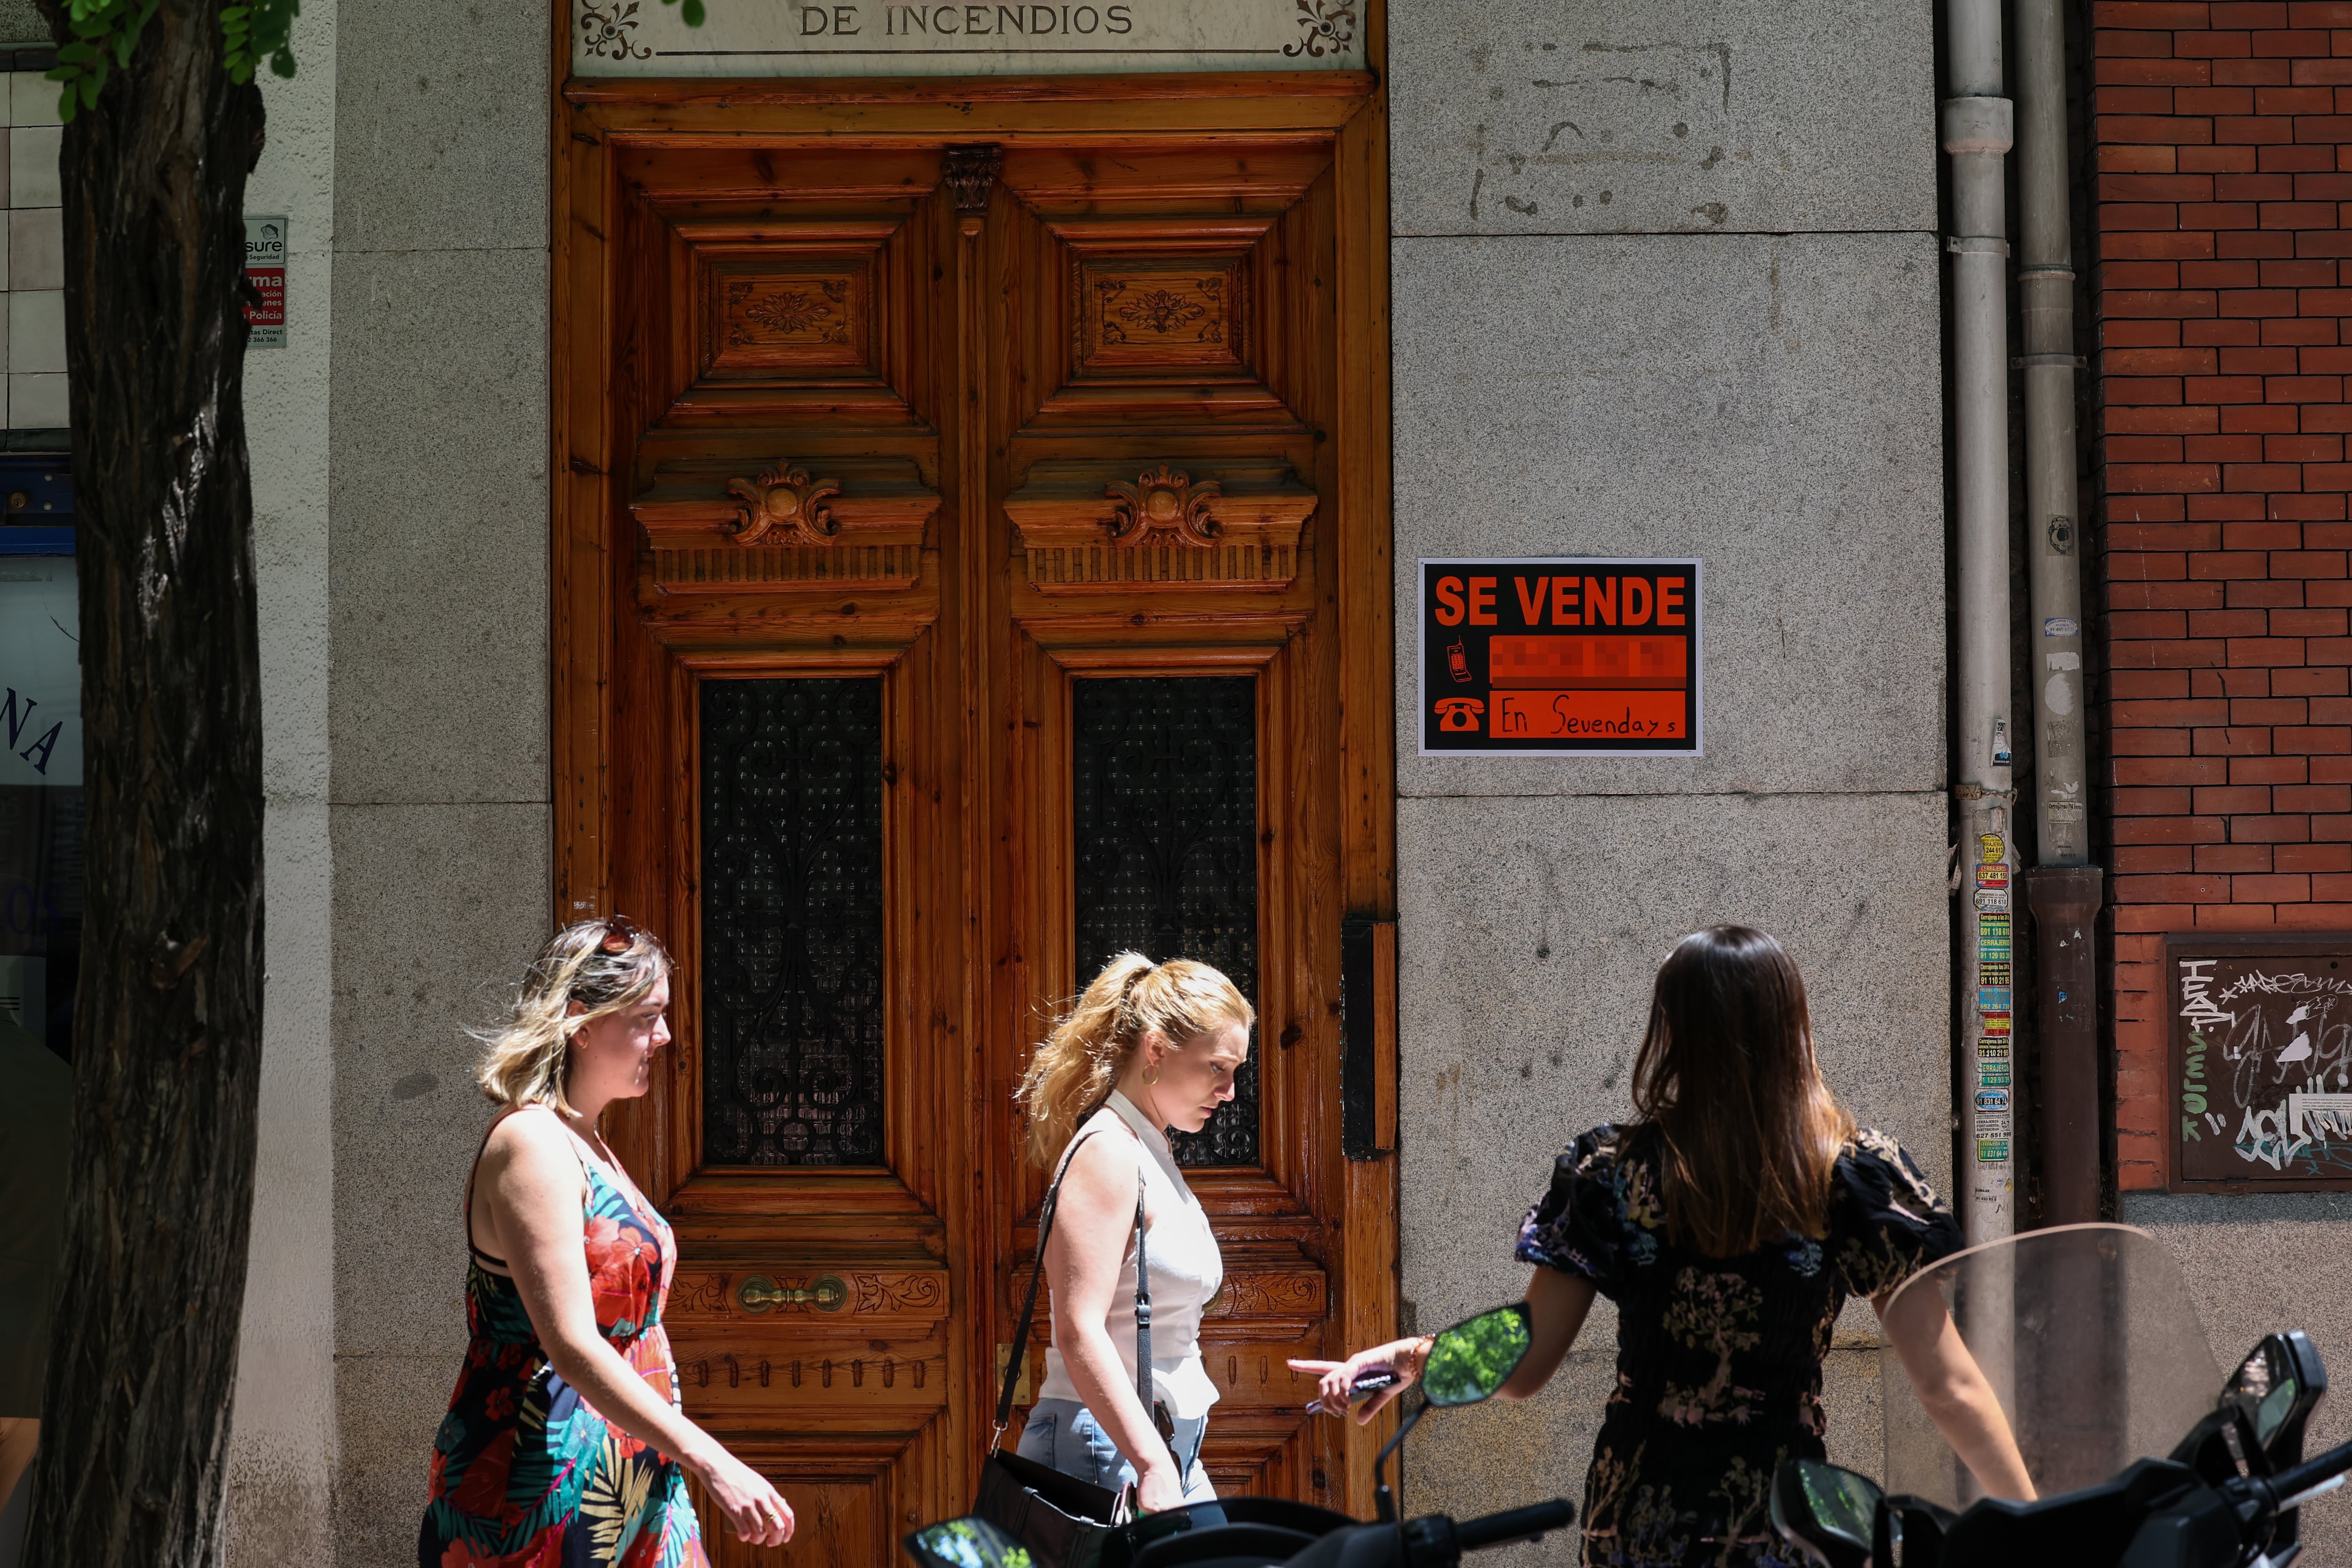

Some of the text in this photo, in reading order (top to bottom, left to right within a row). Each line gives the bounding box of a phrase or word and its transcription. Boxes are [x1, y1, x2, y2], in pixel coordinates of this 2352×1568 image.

[800, 5, 1133, 36] DE INCENDIOS
[249, 311, 282, 320] Policía
[1435, 576, 1686, 626] SE VENDE
[1502, 697, 1528, 733] En
